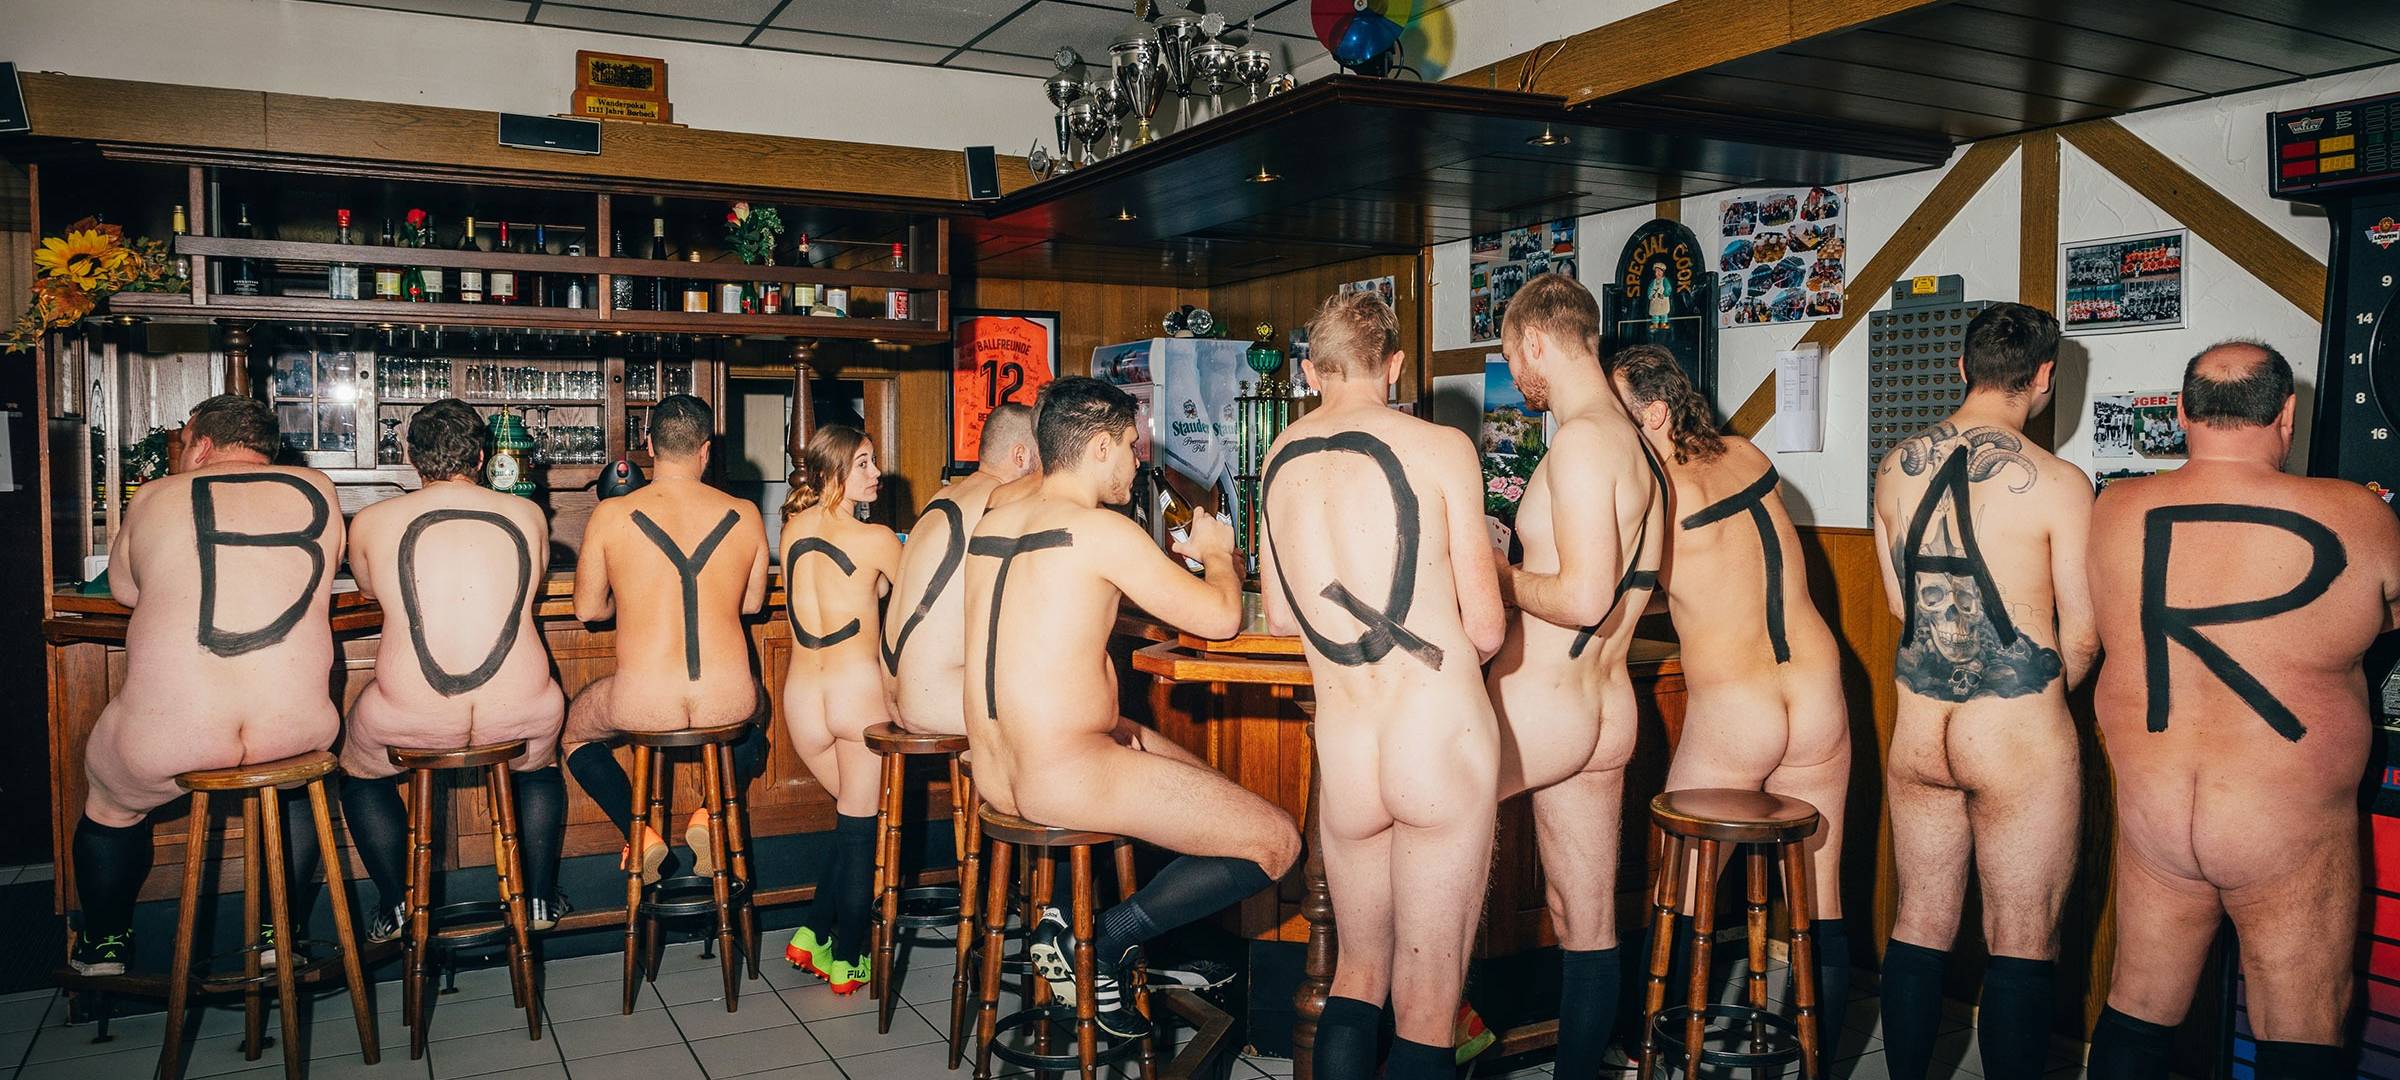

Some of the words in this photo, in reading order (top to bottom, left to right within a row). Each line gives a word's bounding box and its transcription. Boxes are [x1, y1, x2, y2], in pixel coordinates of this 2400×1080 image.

[598, 99, 646, 109] Wanderpokal
[627, 109, 656, 118] Borbeck
[1626, 234, 1668, 298] SPECIAL
[1673, 242, 1693, 293] COOK
[2381, 275, 2392, 287] 9
[2356, 312, 2373, 325] 14
[976, 338, 1032, 356] BALLFREUNDE
[2349, 353, 2363, 364] 11
[980, 359, 1024, 409] 12
[2355, 392, 2366, 404] 8
[2371, 428, 2388, 440] 16
[847, 970, 866, 979] FILA
